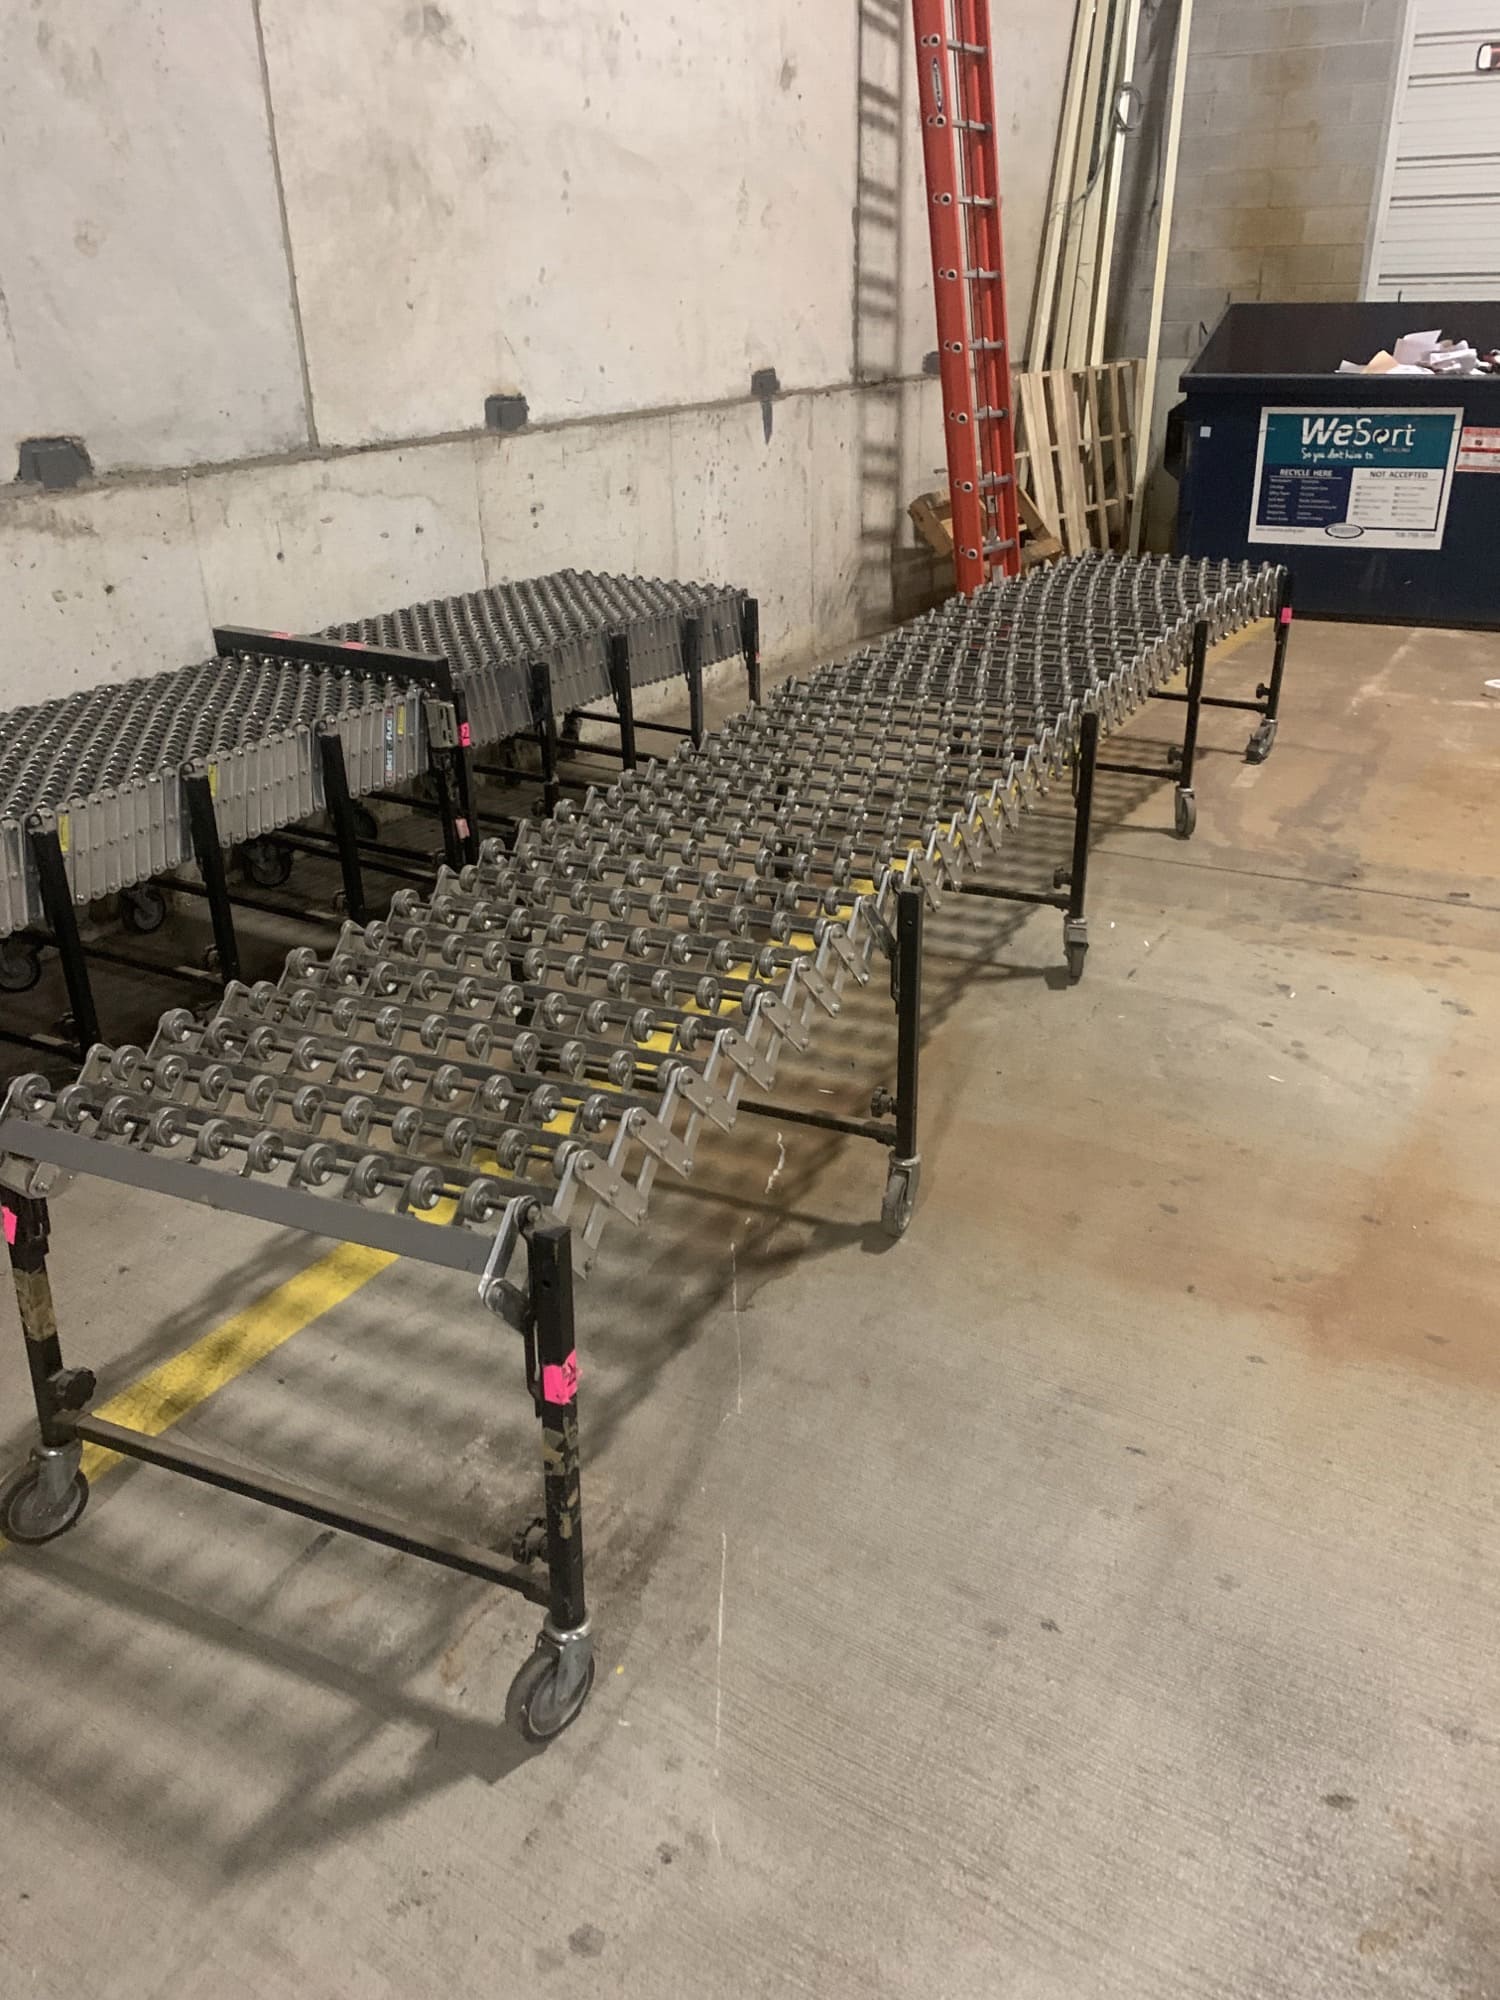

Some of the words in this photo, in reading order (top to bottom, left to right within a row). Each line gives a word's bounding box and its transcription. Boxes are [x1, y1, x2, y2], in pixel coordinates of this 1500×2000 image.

[1301, 417, 1416, 446] WeSort
[1279, 468, 1310, 476] RECYCLE
[1313, 469, 1333, 477] HERE
